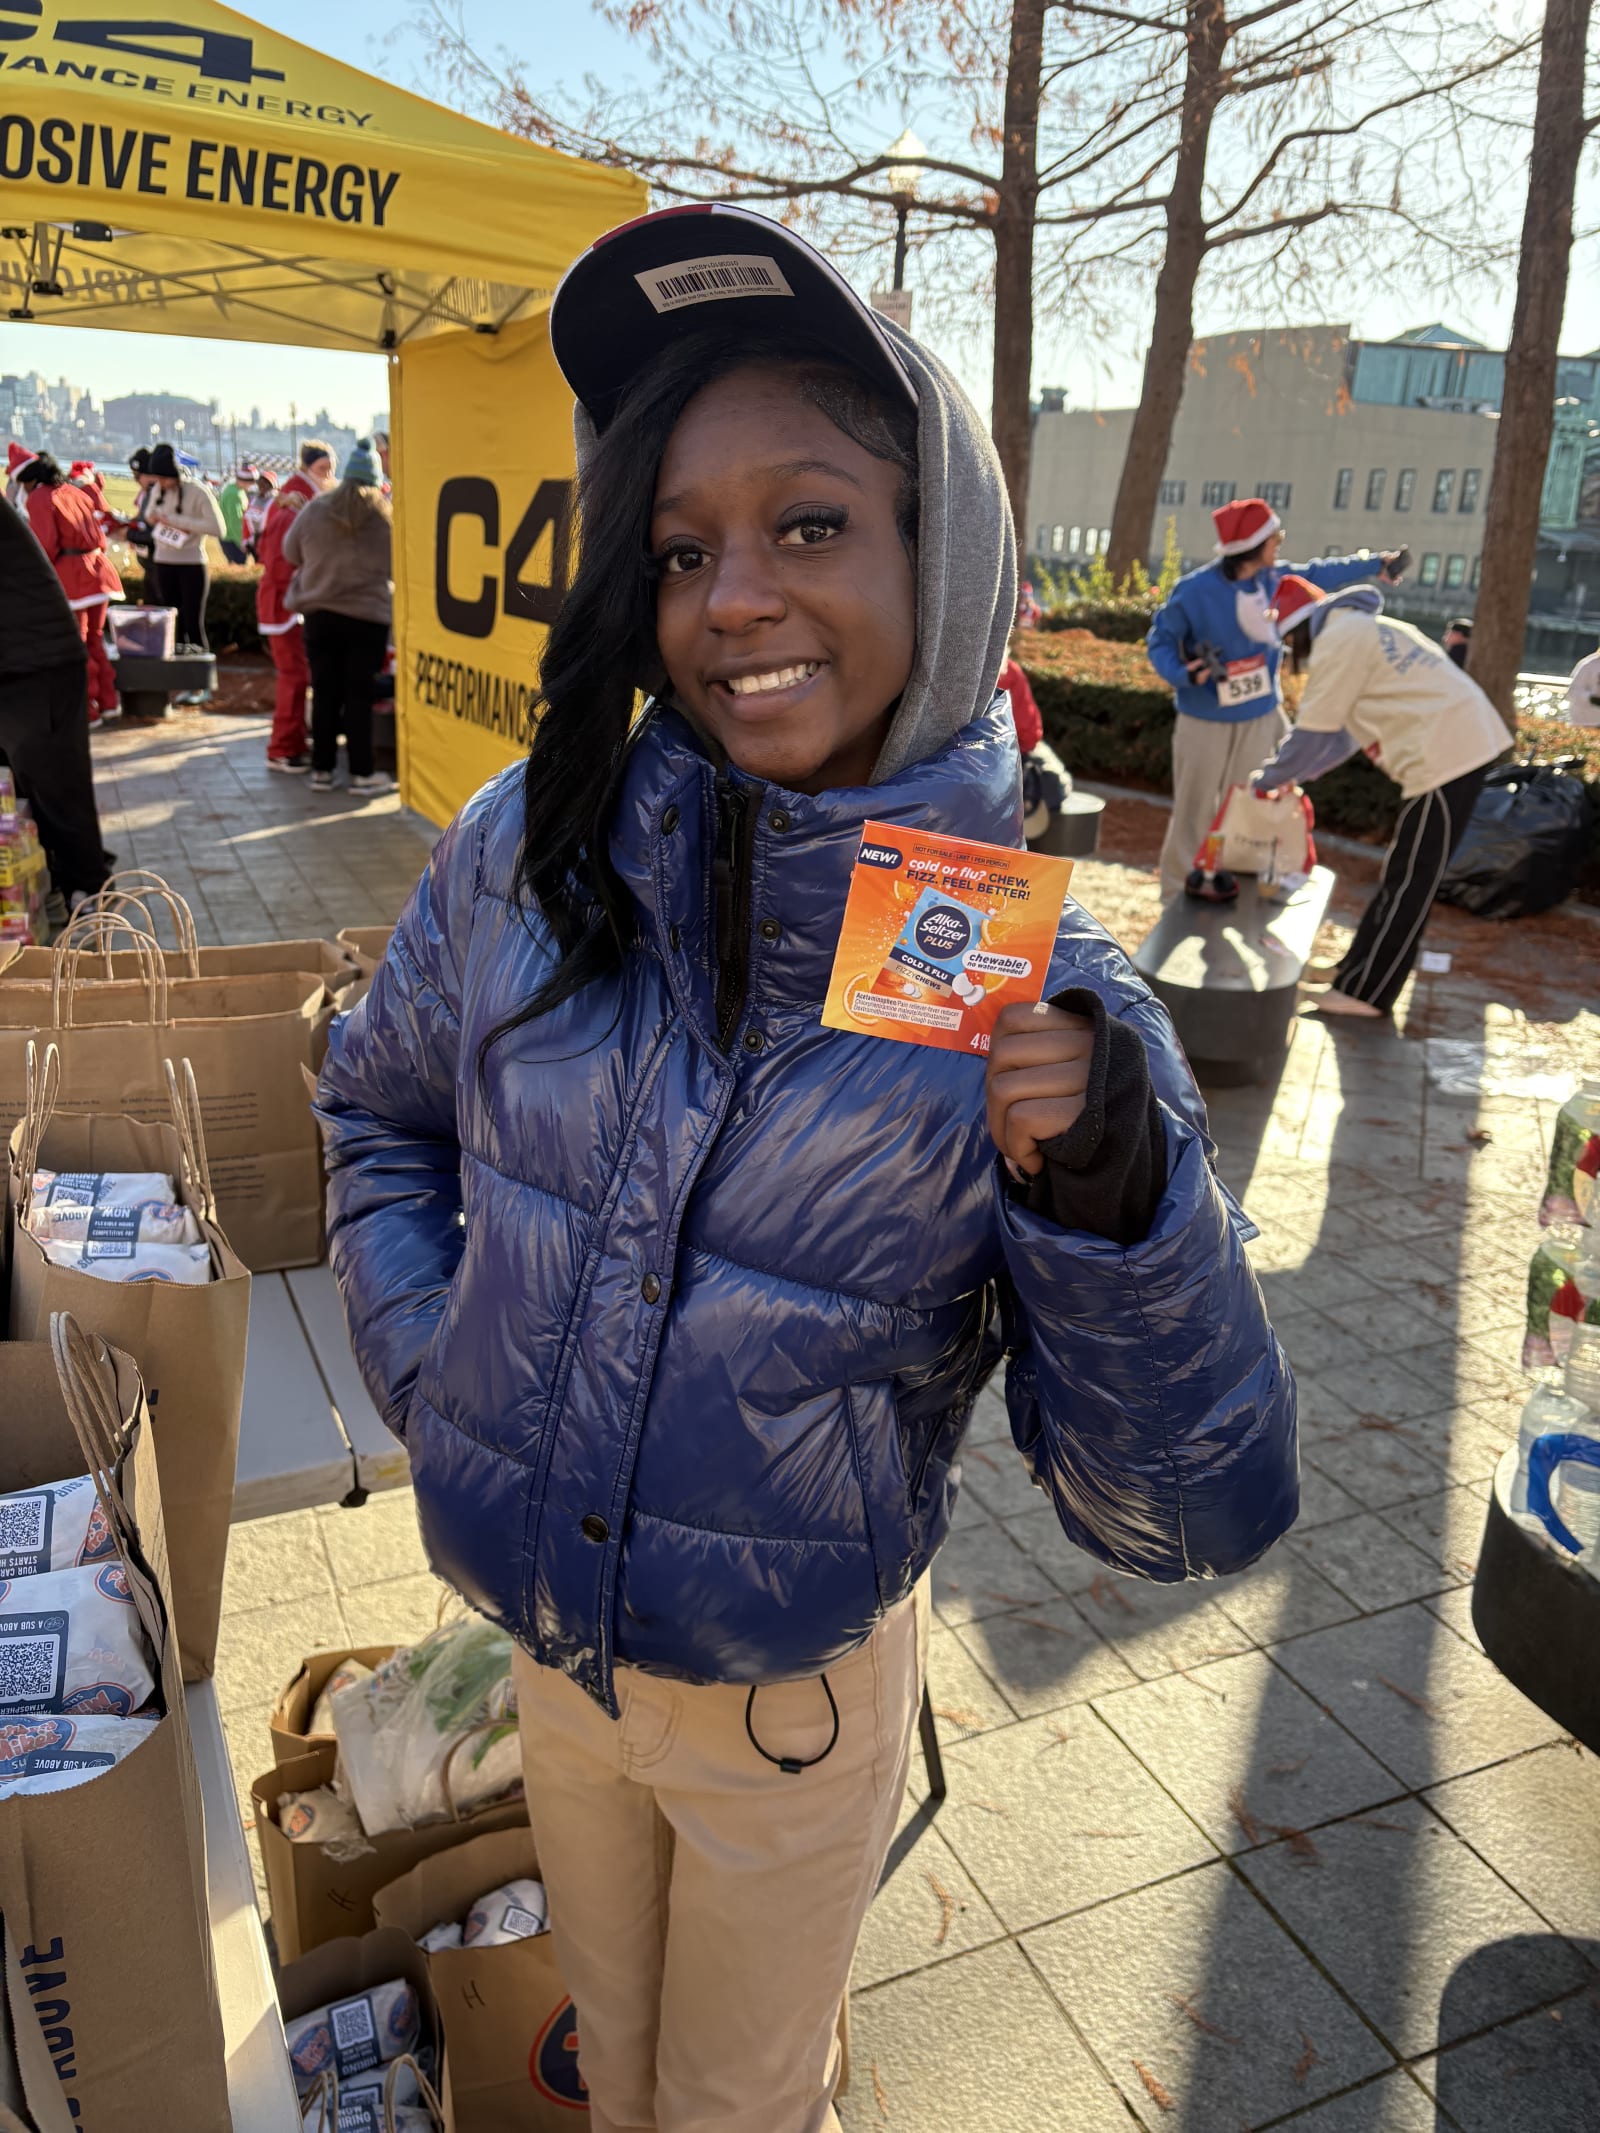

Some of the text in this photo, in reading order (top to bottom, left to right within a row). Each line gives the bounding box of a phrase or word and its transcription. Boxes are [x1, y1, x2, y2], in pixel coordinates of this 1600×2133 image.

[0, 0, 285, 83] 4
[0, 53, 374, 128] ANCE ENERGY
[0, 114, 400, 227] OSIVE ENERGY
[435, 476, 574, 639] C4
[1229, 673, 1263, 699] 539
[416, 652, 541, 748] PERFORMANC
[861, 848, 898, 864] NEW!
[909, 859, 1030, 888] cold or flu? CHEW.
[907, 870, 1031, 900] FIZZ. FEEL BETTER!
[928, 913, 964, 929] Alka-
[919, 921, 967, 941] Seltzer
[923, 935, 954, 950] PLUS
[901, 955, 949, 980] COLD & FLU
[969, 953, 1028, 970] chewable!
[977, 962, 997, 972] water
[998, 966, 1024, 975] needed
[970, 1032, 980, 1048] 4
[55, 1481, 84, 1498] SUB
[9, 1555, 38, 1567] STARTS
[18, 1566, 38, 1576] YOUR
[21, 1621, 35, 1630] SUB
[38, 1621, 43, 1629] A
[34, 1759, 60, 1769] ABOVE
[63, 1760, 79, 1770] SUB
[462, 1980, 486, 2009] H
